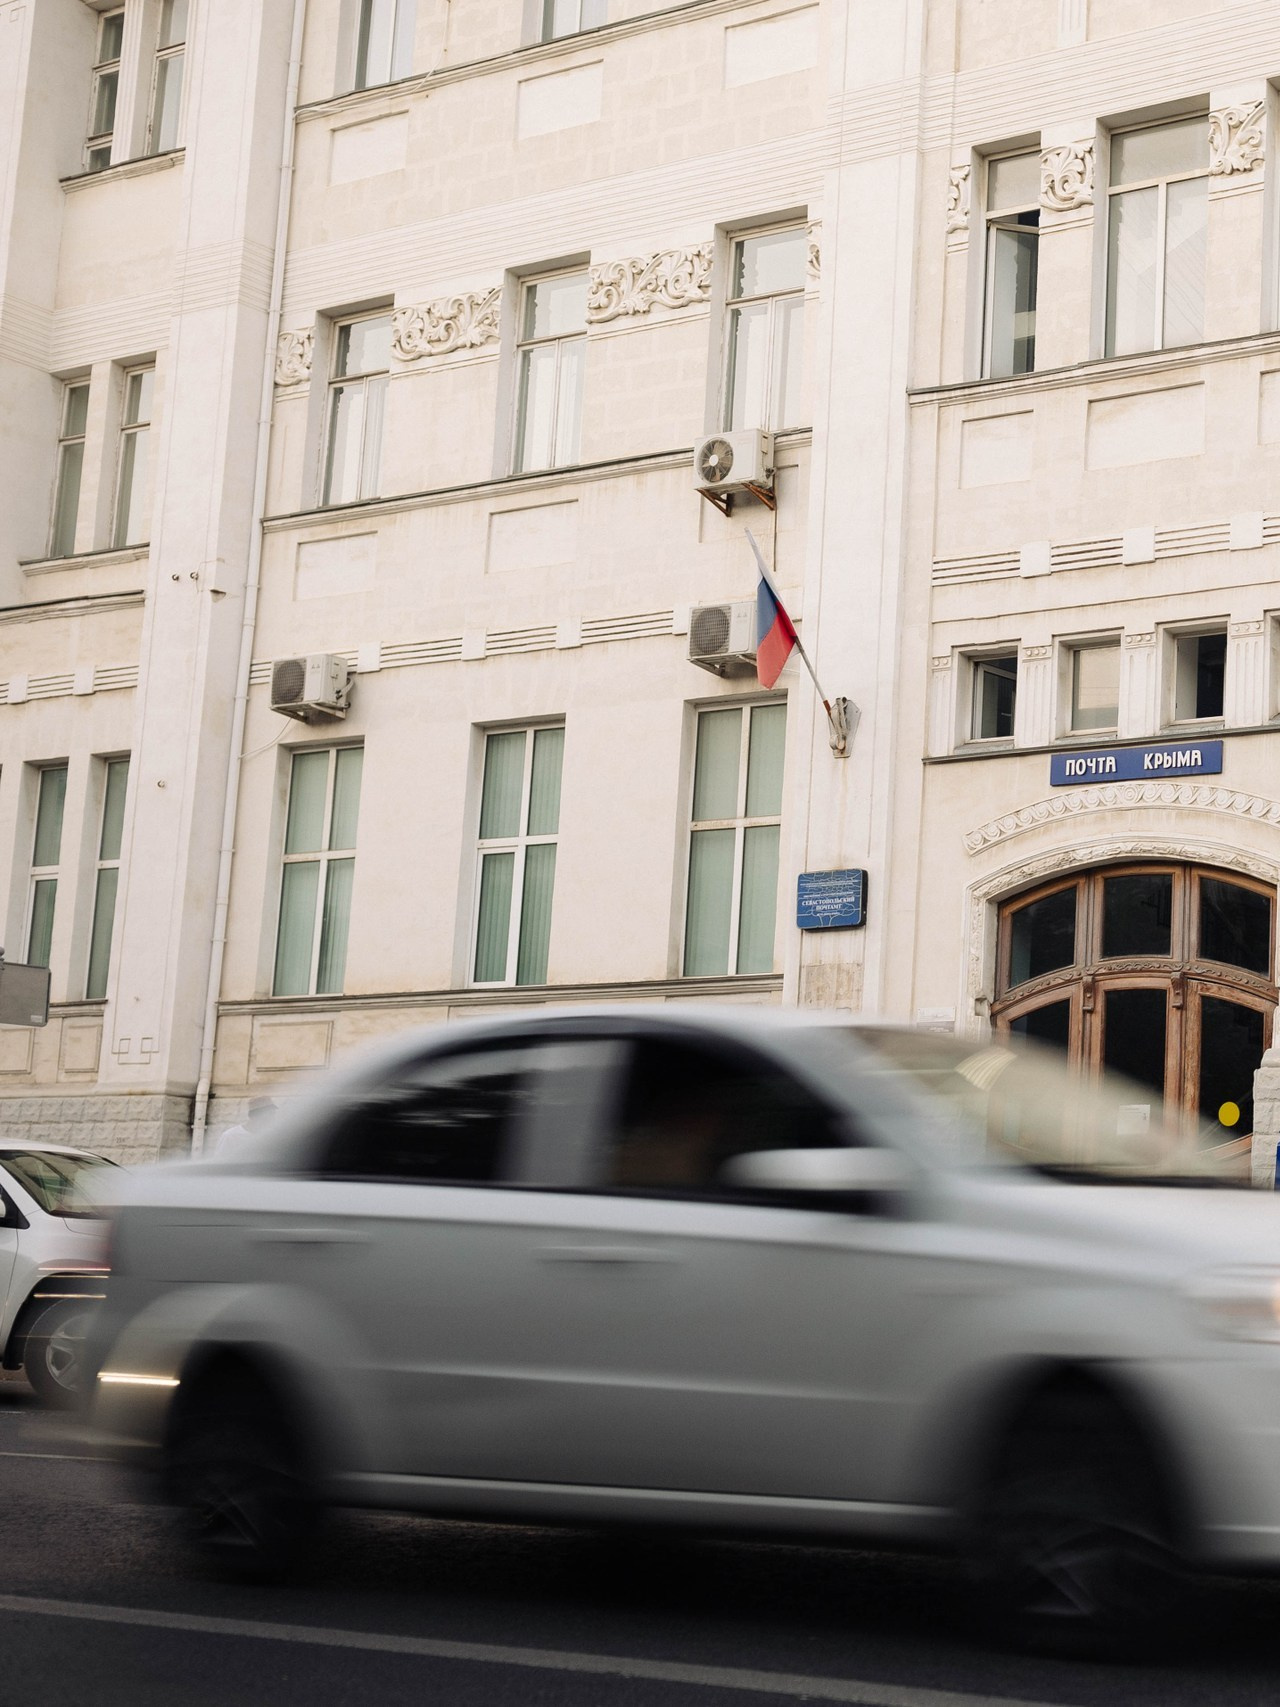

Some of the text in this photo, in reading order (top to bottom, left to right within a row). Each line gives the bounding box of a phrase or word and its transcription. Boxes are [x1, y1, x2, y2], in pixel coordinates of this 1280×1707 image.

[1065, 749, 1202, 776] ПОЧТА КРЫМА
[802, 896, 854, 906] СЕВАСТОПОЛЬСКИЙ
